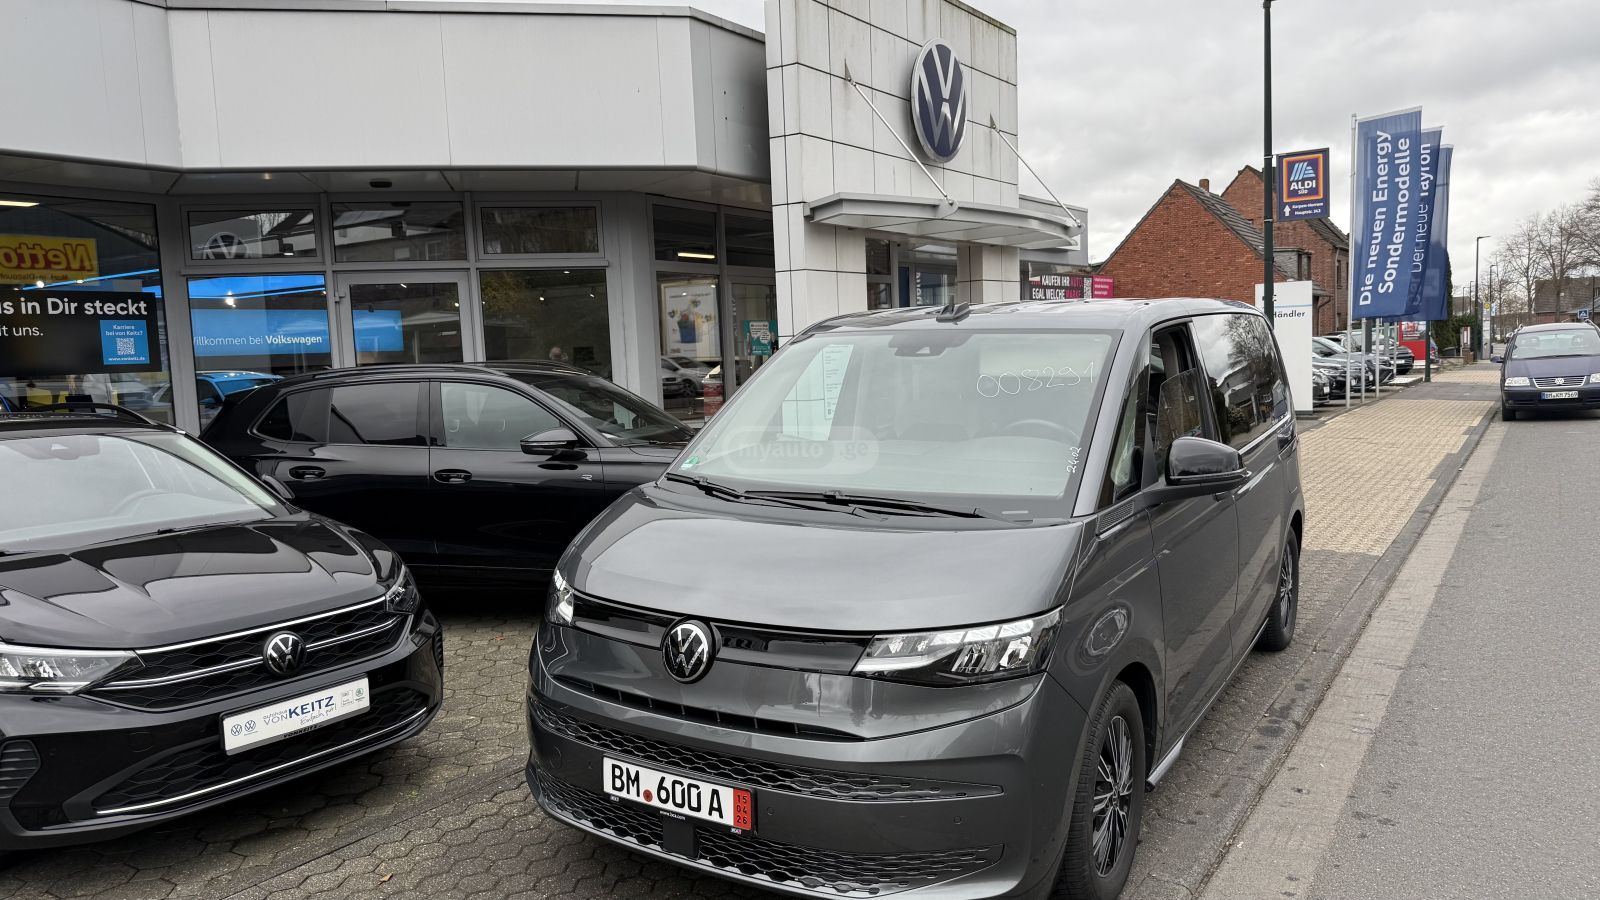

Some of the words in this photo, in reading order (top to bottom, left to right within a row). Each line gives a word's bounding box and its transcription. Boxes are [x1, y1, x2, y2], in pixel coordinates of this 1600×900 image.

[1372, 131, 1392, 202] Energy
[1290, 179, 1316, 190] ALDI
[1377, 137, 1410, 293] Sondermodelle
[1415, 204, 1429, 243] neue
[1367, 207, 1387, 269] neuen
[1041, 274, 1061, 287] KAUFEN
[1061, 276, 1070, 287] IHR
[1032, 287, 1045, 300] EGAL
[1045, 288, 1065, 300] WELCHE
[1359, 274, 1374, 306] Die
[0, 300, 15, 315] s
[20, 297, 41, 315] in
[47, 298, 78, 315] Dir
[83, 299, 148, 316] steckt
[13, 325, 44, 337] uns.
[194, 335, 247, 346] illkommen
[249, 335, 263, 345] bei
[265, 334, 323, 346] Volkswagen
[611, 763, 641, 798] BM
[656, 776, 702, 812] 600
[708, 788, 724, 819] A
[736, 794, 748, 804] 15
[736, 804, 748, 815] 04
[736, 814, 748, 825] 26
